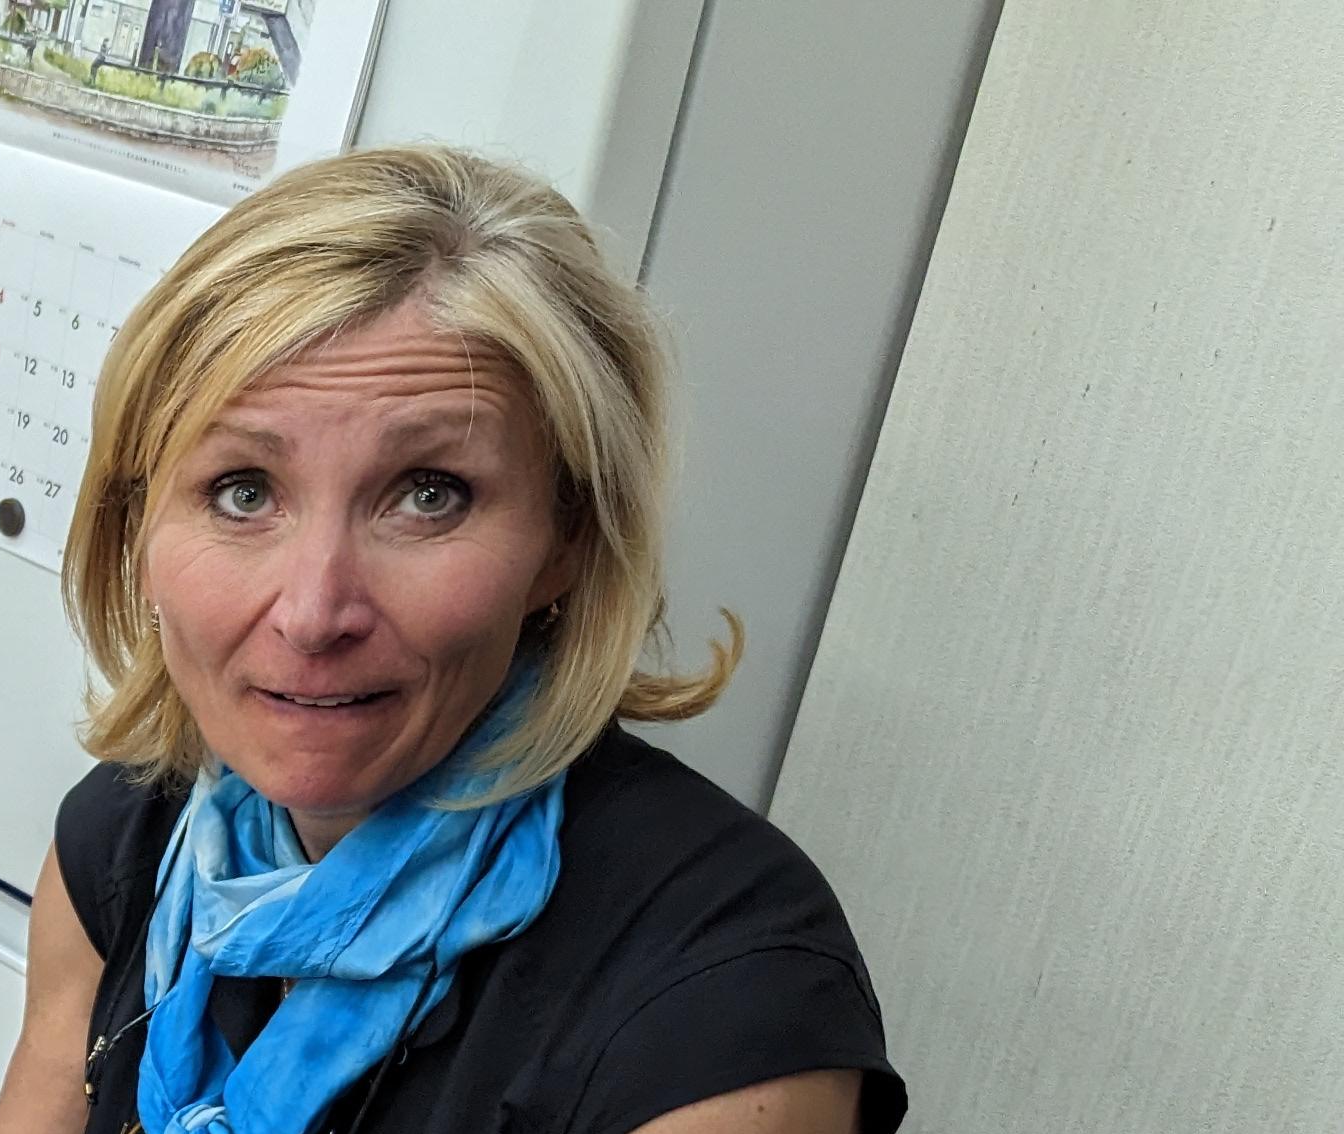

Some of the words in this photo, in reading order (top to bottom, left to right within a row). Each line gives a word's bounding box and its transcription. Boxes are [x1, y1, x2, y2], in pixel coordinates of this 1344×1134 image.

[32, 301, 42, 317] 5
[71, 314, 80, 330] 6
[23, 356, 37, 375] 12
[61, 369, 75, 389] 13
[16, 411, 30, 429] 19
[52, 425, 69, 446] 20
[9, 465, 24, 485] 26
[44, 480, 62, 499] 27
